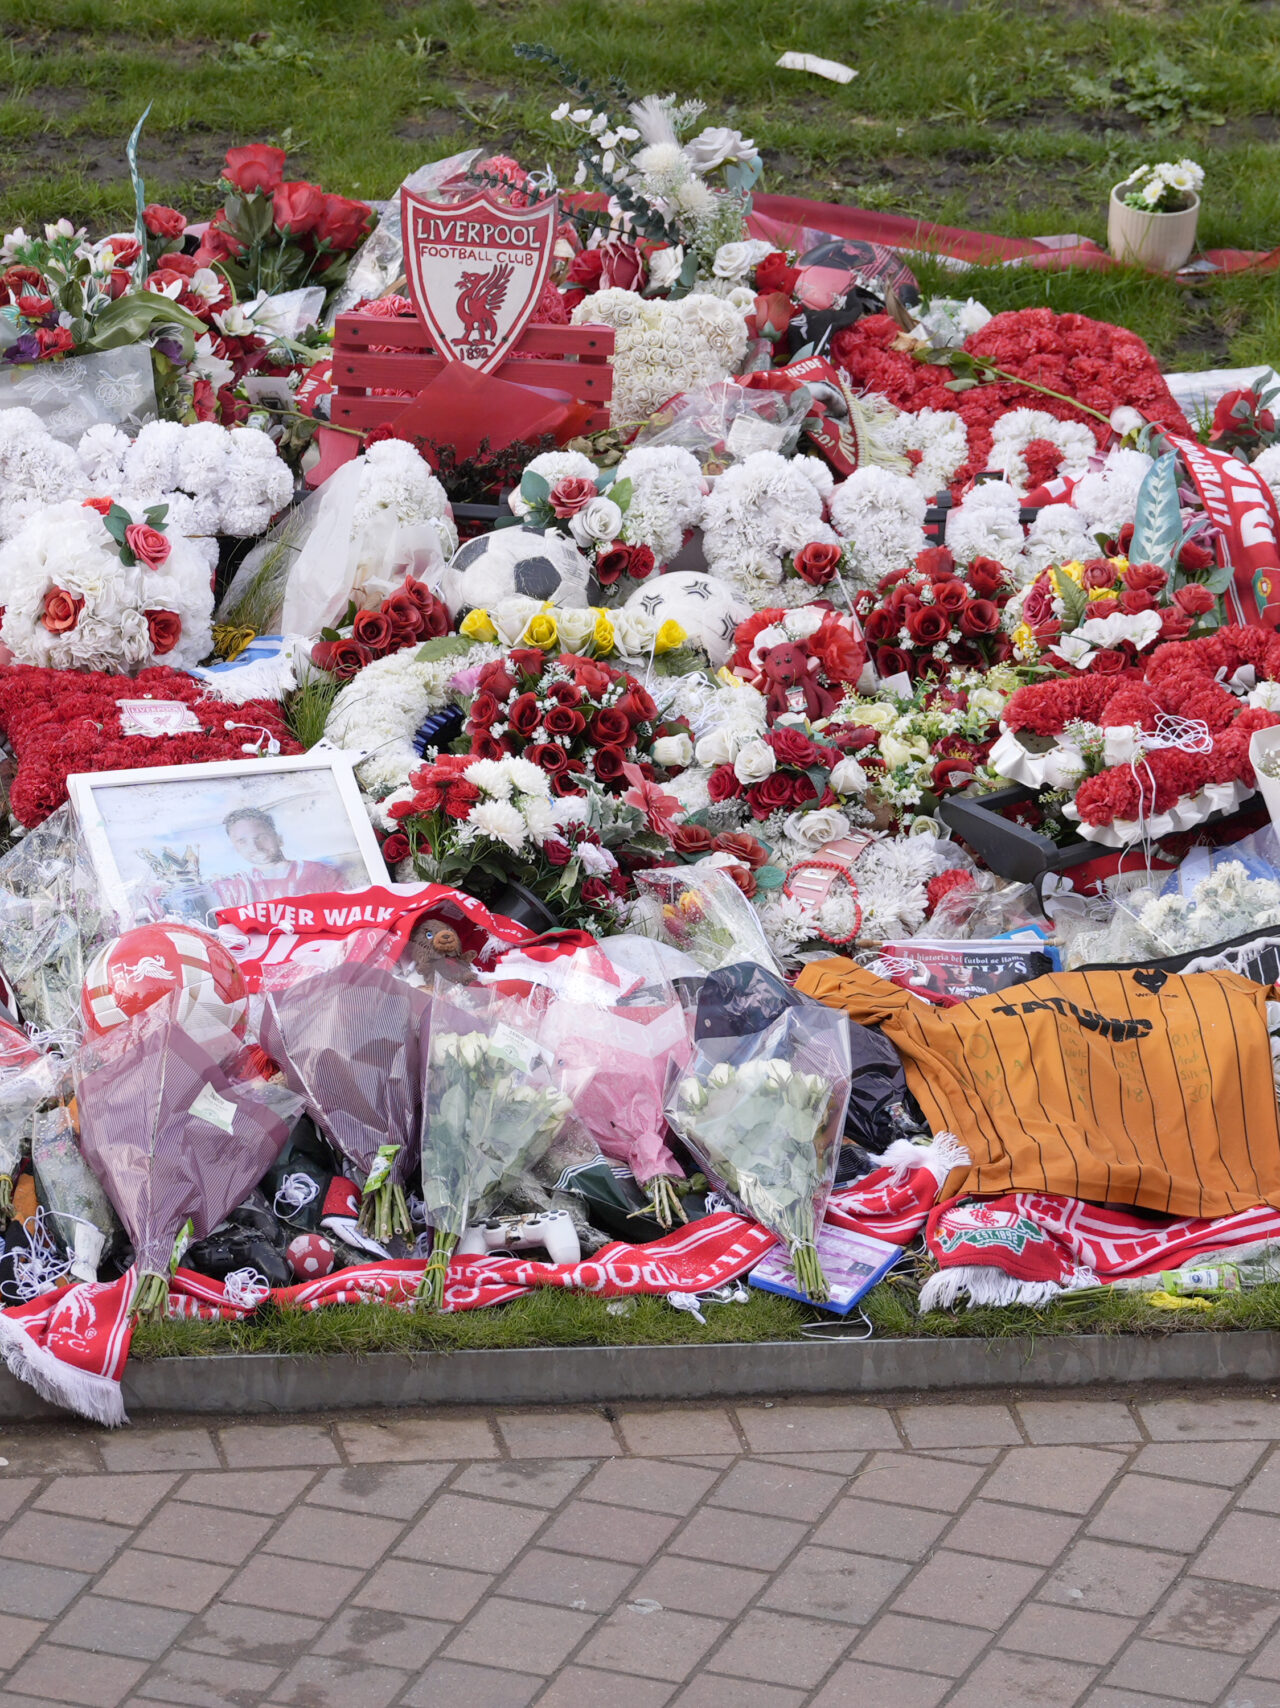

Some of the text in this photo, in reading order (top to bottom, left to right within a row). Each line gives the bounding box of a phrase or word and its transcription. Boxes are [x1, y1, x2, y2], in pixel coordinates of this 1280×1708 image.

[416, 217, 541, 248] LIVERPOOL
[420, 245, 534, 266] FOOTBALL CLUB
[237, 901, 314, 927] NEVER
[323, 904, 396, 927] WALK
[916, 953, 949, 962] historia
[951, 954, 963, 963] del
[110, 961, 128, 994] LFC
